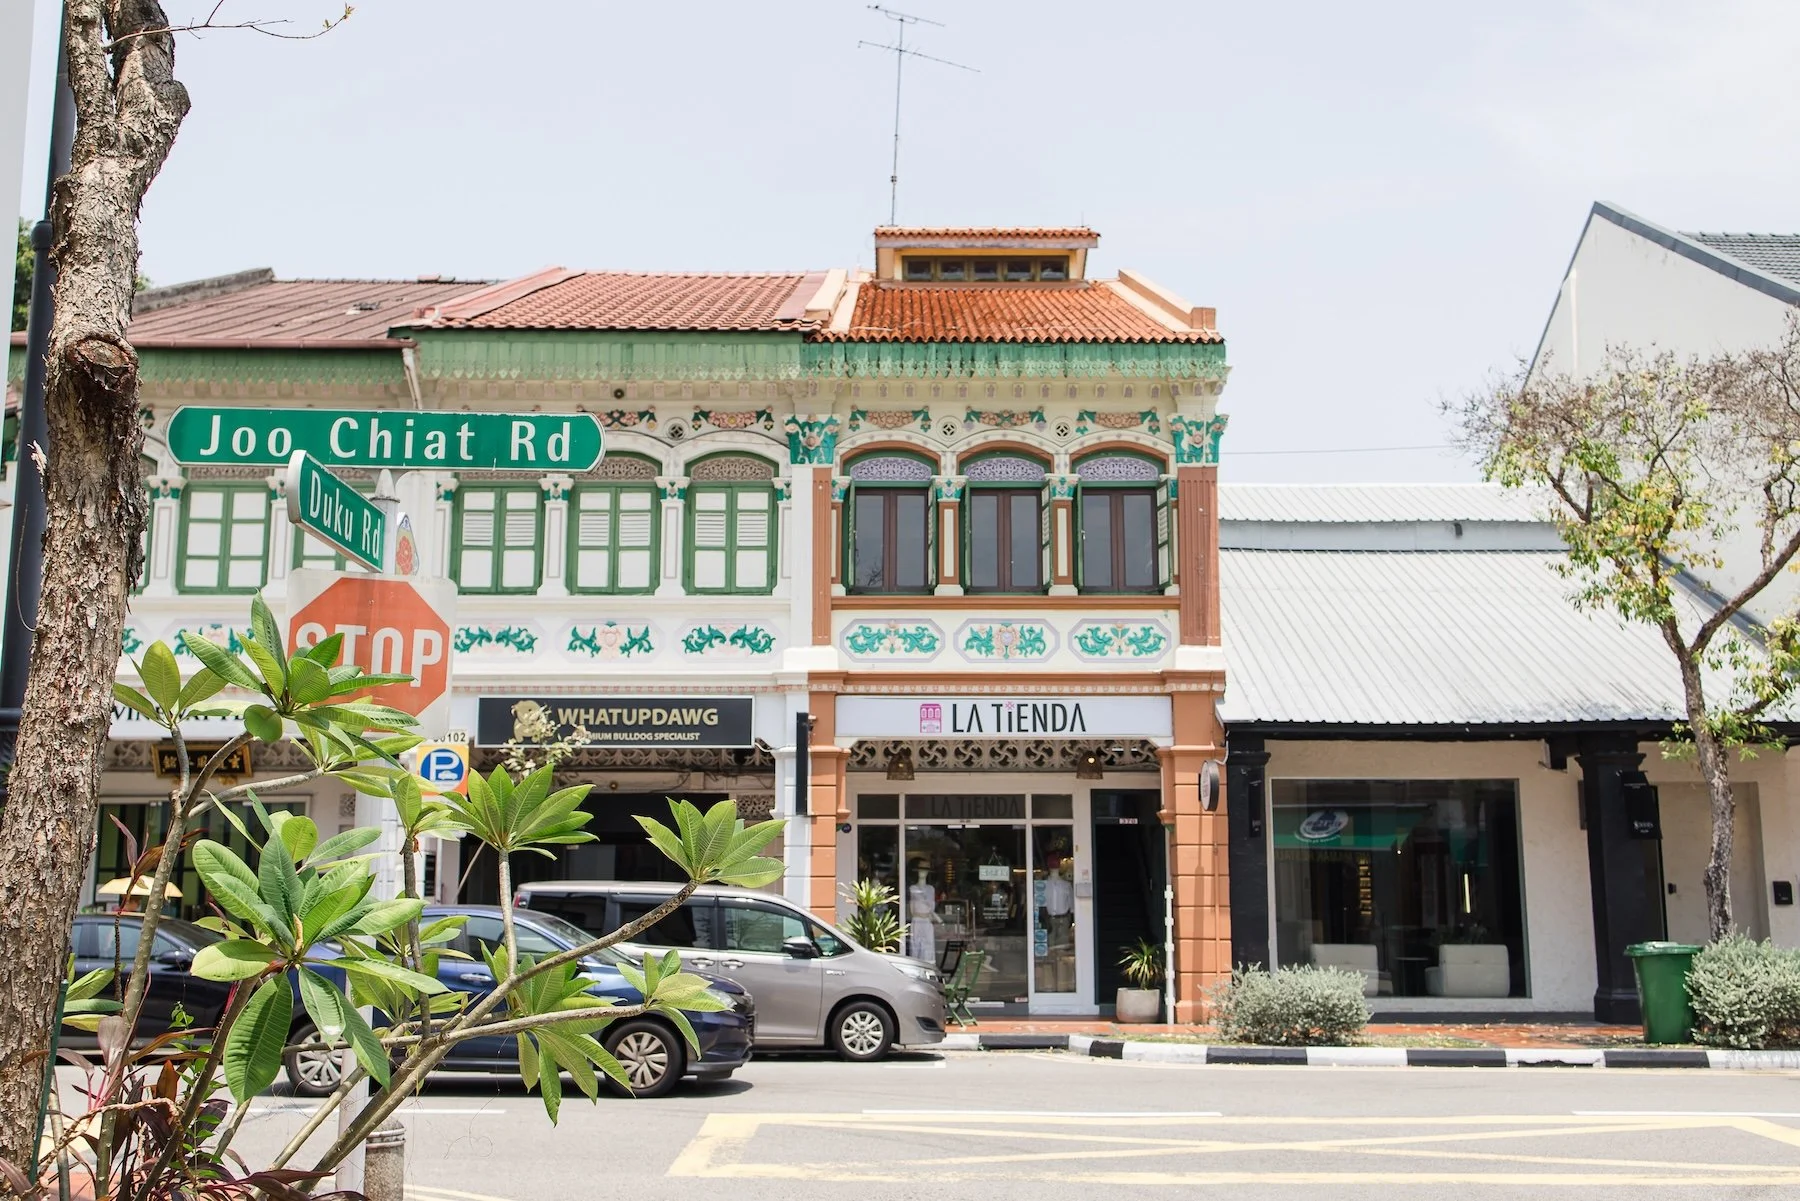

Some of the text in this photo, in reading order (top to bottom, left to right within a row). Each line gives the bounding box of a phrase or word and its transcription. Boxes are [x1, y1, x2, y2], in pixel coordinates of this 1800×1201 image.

[200, 414, 571, 462] Joo Chiat Rd
[309, 469, 382, 560] Duku Rd
[557, 708, 719, 726] WHATUPDAWG
[952, 703, 983, 733] LA
[612, 732, 653, 741] BULLDOG
[653, 732, 701, 741] SPECIALIST
